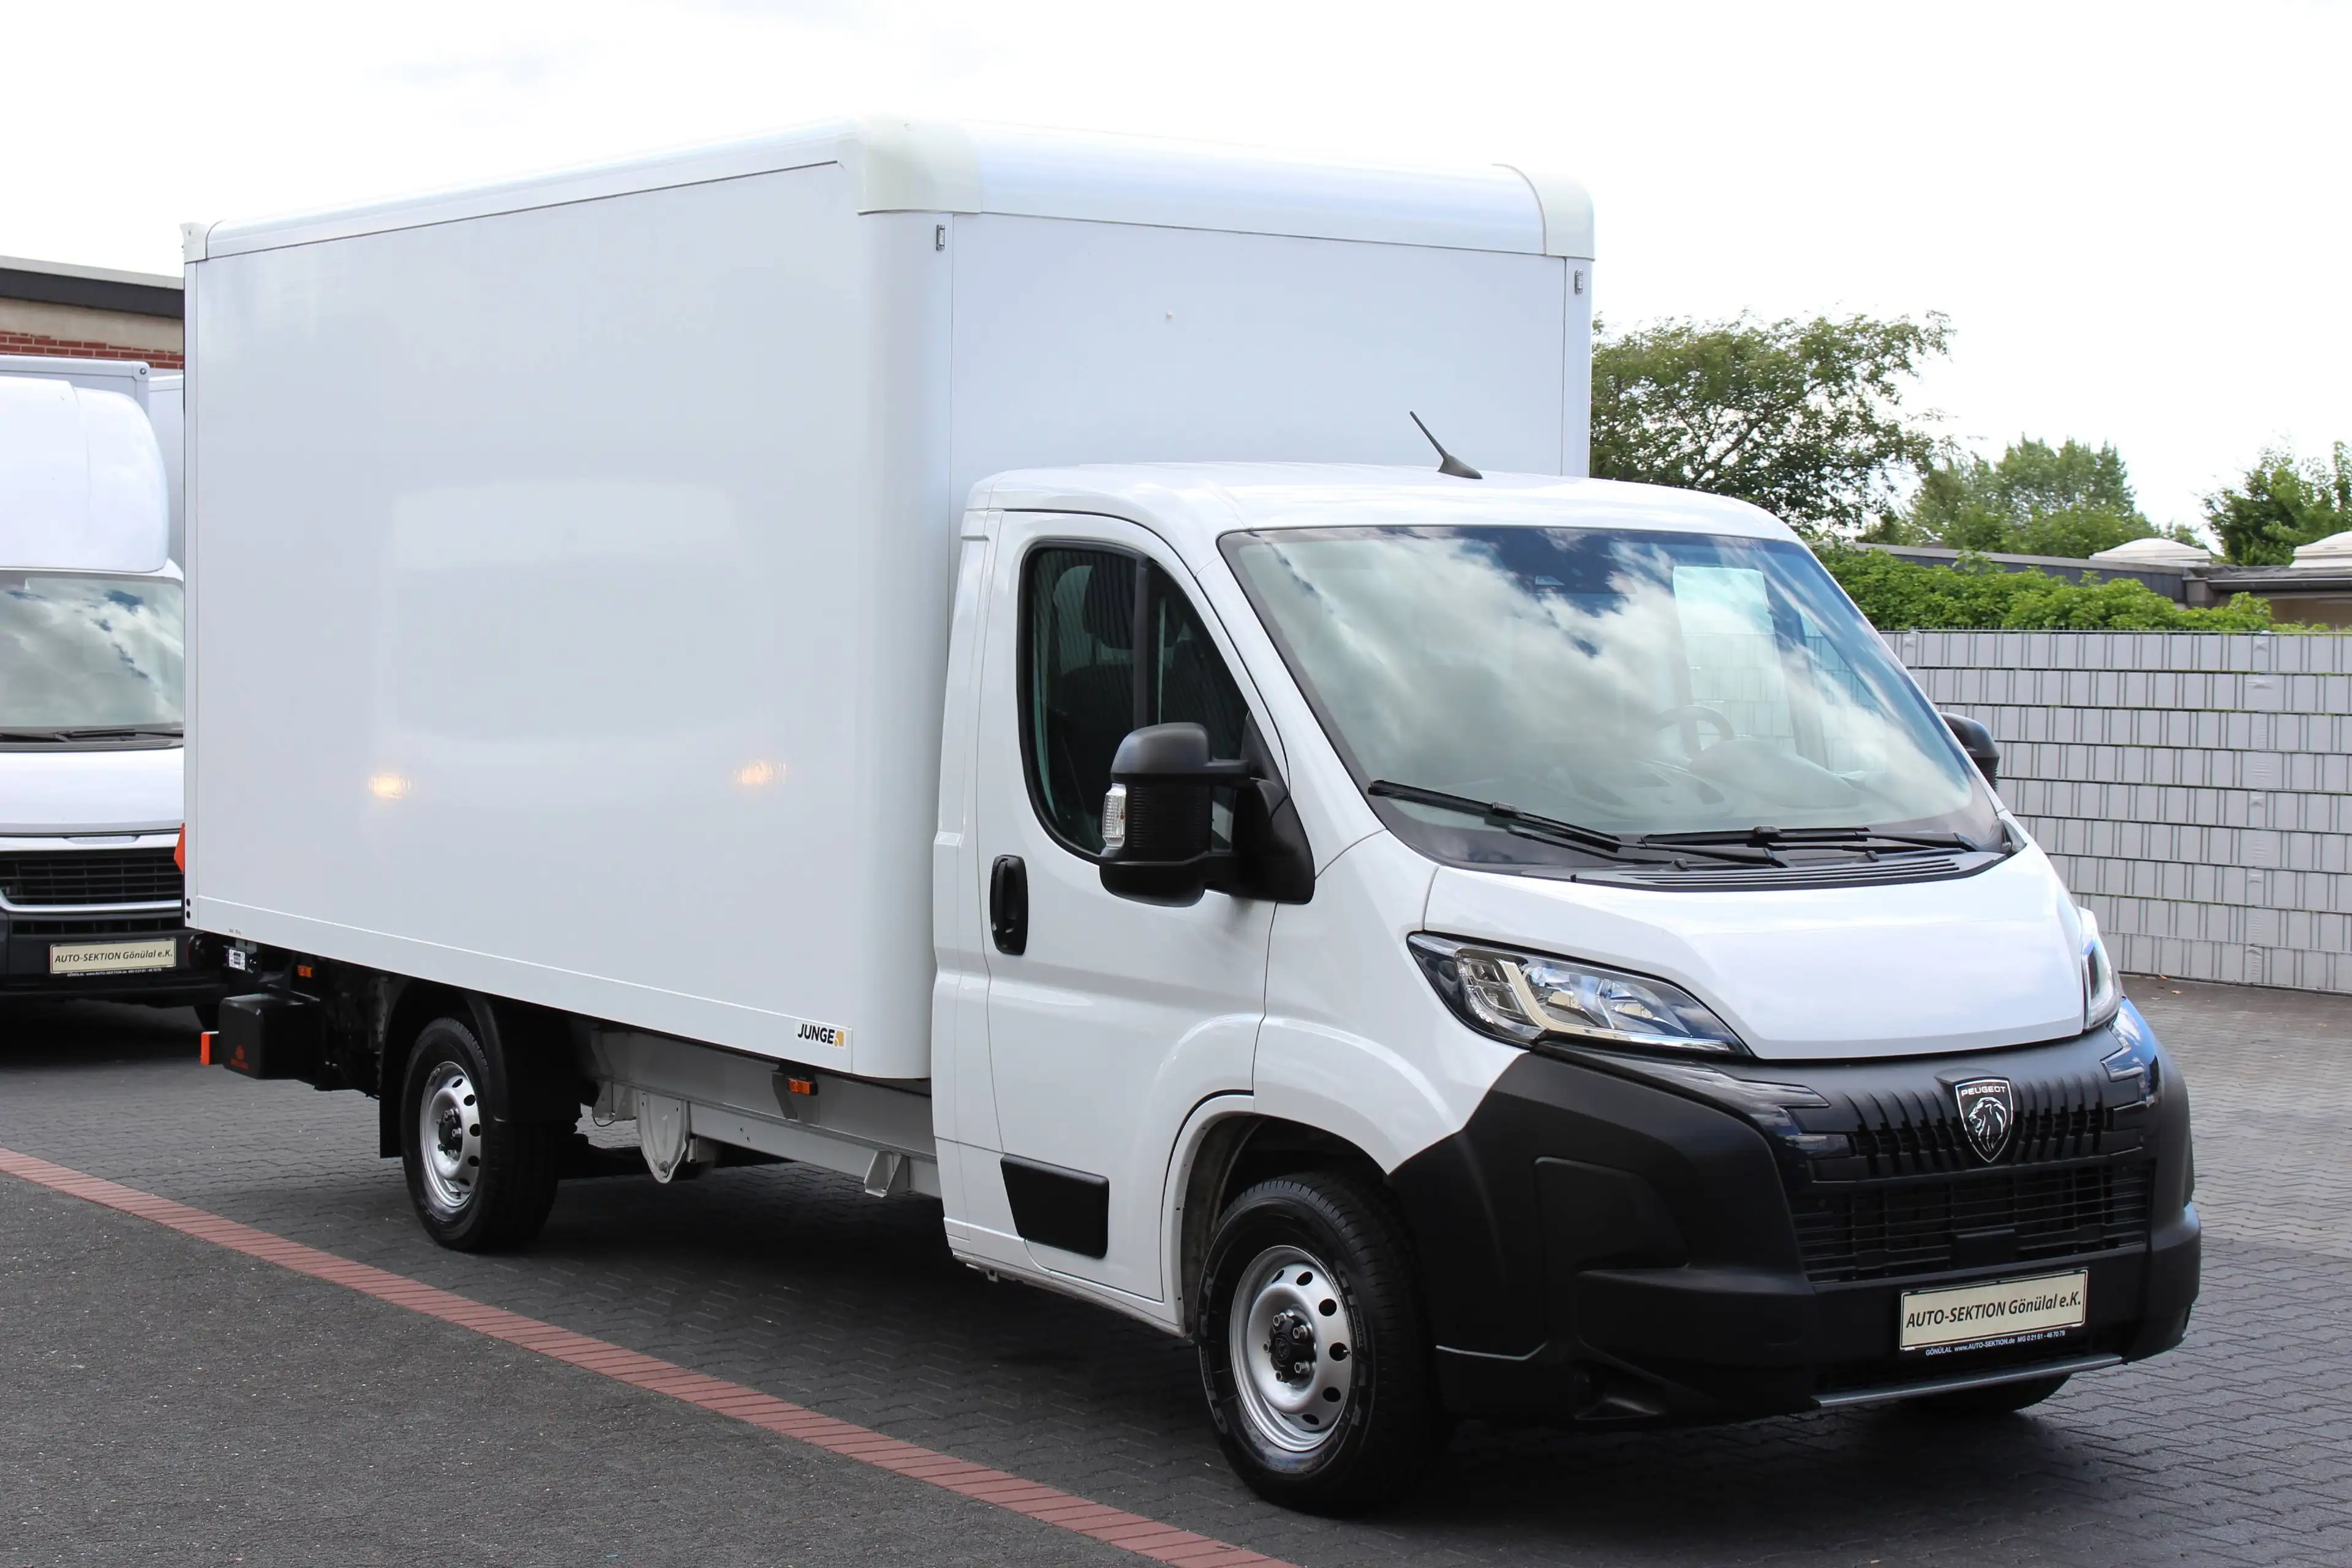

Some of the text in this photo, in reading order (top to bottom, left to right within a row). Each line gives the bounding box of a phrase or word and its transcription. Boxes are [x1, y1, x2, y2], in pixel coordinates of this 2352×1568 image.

[55, 949, 173, 963] AUTO-SEKTION Gönülal e.K.
[797, 1023, 835, 1044] JUNGE
[1961, 1085, 2007, 1097] PEUGEOT
[1906, 1291, 2081, 1329] AUTO-SEKTION Gönülal e.K.
[1926, 1346, 1952, 1356] GÖNÜLAL
[1954, 1338, 2016, 1352] www.AUTO-SEKTION.de
